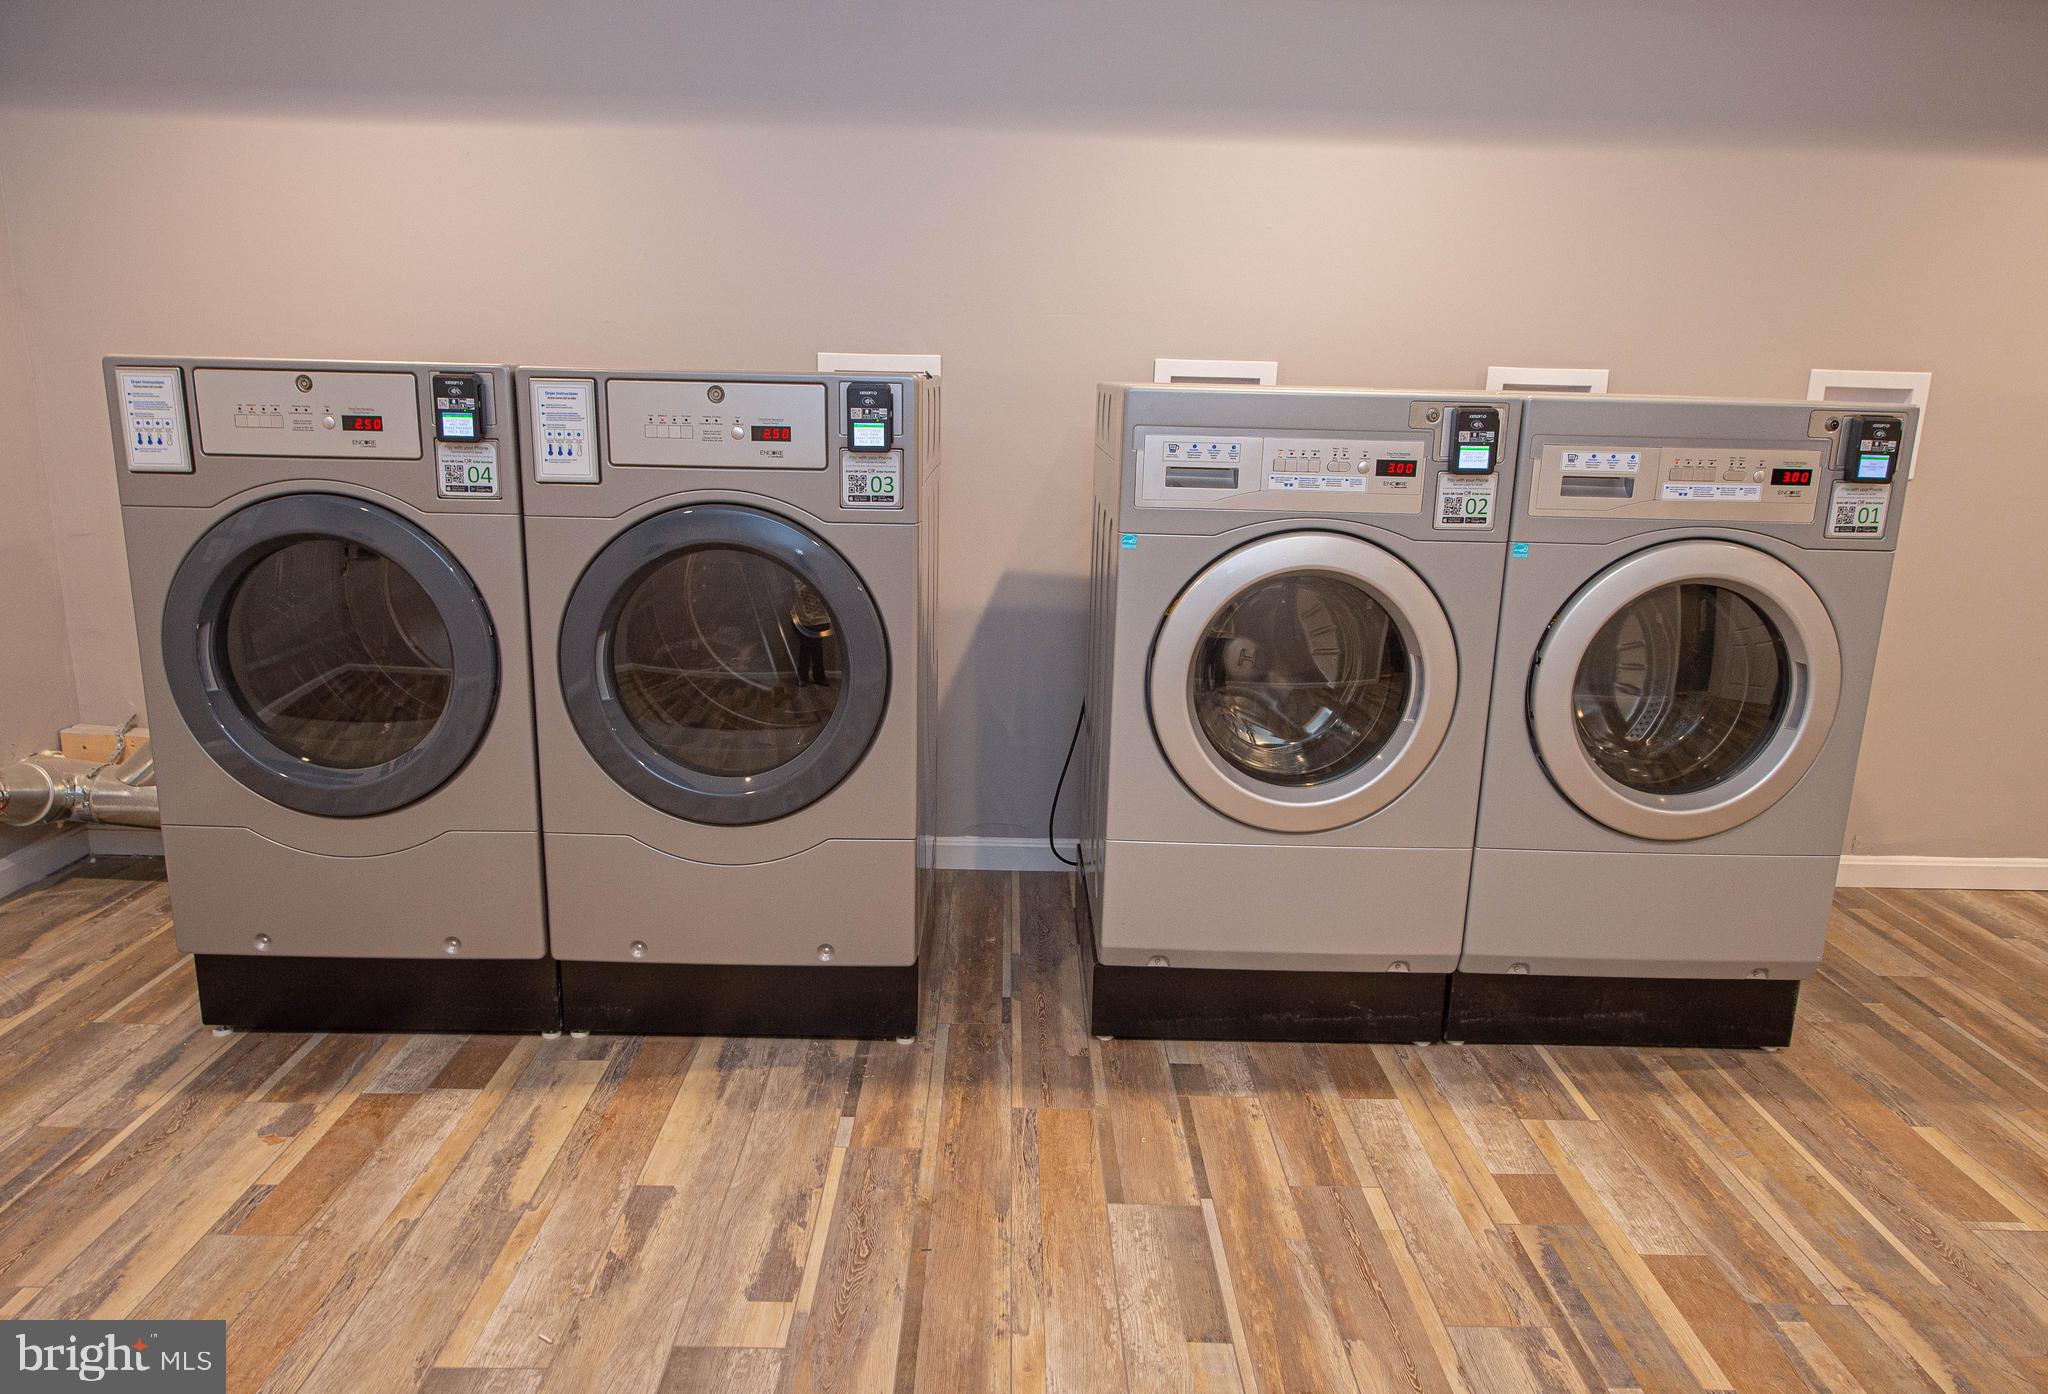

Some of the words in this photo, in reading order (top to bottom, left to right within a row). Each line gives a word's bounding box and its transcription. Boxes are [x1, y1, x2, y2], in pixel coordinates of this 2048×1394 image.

[467, 466, 493, 484] 04
[870, 476, 894, 493] 03
[1465, 498, 1488, 515] 02
[1857, 507, 1880, 524] 01
